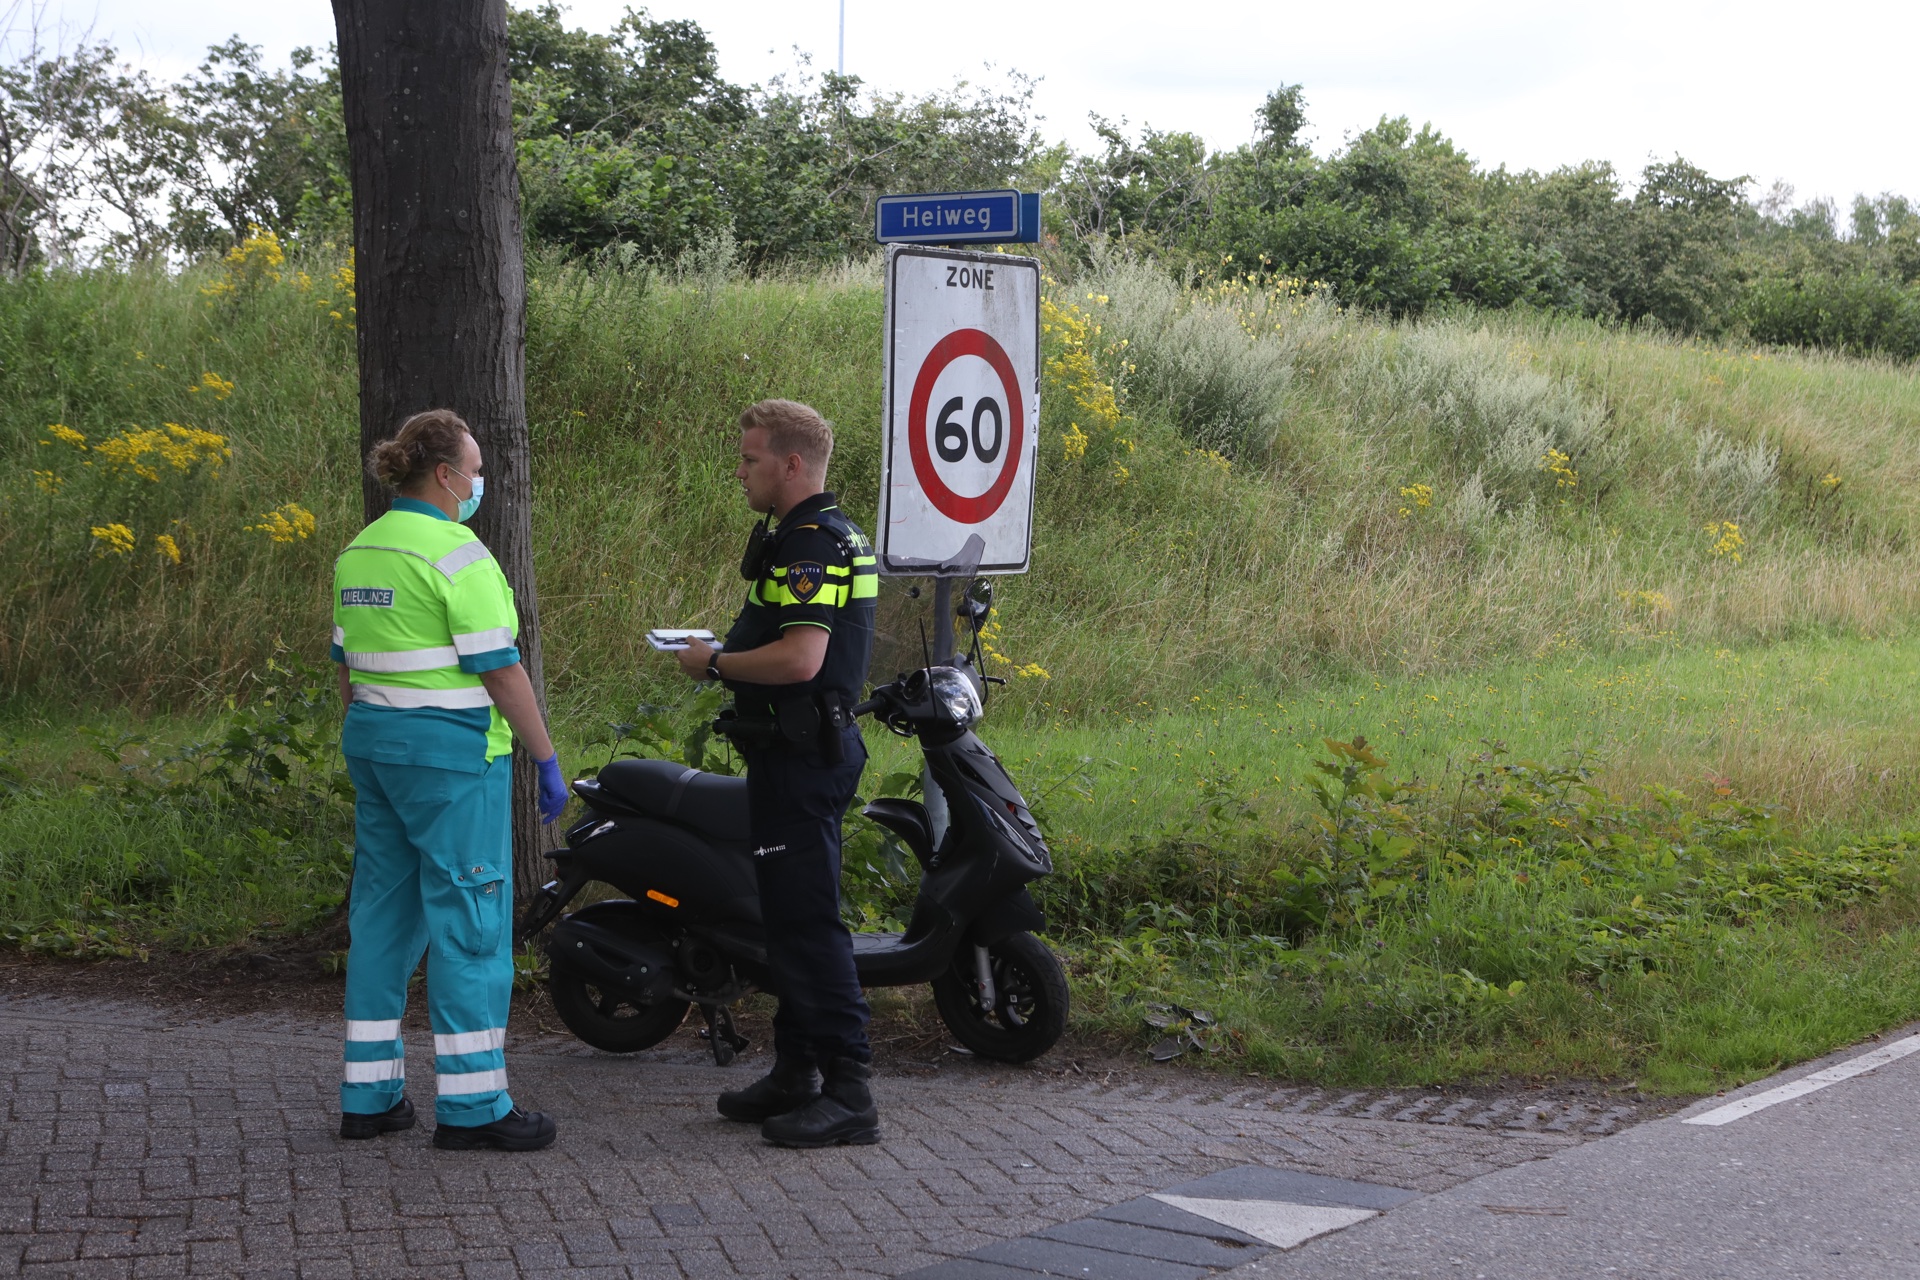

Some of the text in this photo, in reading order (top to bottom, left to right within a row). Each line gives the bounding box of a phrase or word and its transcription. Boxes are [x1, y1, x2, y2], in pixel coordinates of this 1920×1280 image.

[903, 206, 991, 231] Heiweg
[946, 266, 994, 290] ZONE
[935, 396, 1003, 463] 60
[790, 567, 820, 575] POLITIE
